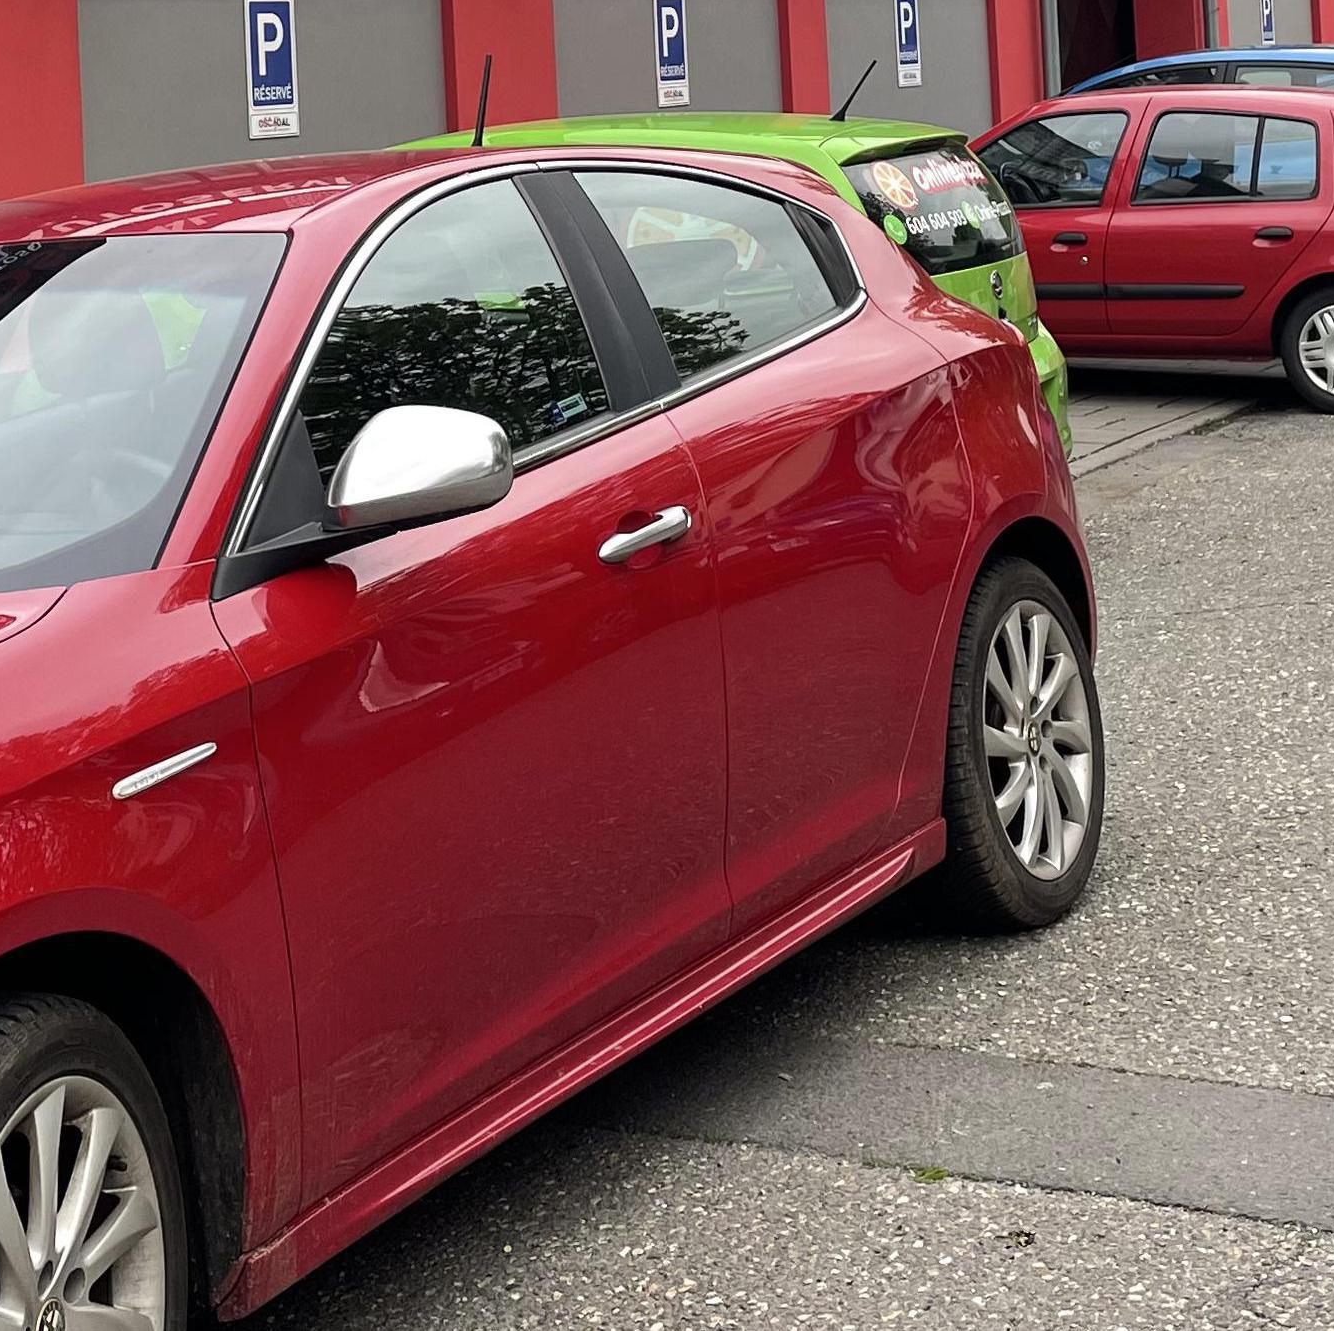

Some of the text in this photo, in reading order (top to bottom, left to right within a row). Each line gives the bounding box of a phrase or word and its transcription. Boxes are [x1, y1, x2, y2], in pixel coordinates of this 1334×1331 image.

[257, 13, 284, 76] P
[661, 6, 679, 57] P
[900, 1, 913, 45] P
[253, 82, 293, 101] RÉSERVÉ
[906, 213, 931, 235] 604
[929, 211, 950, 232] 604
